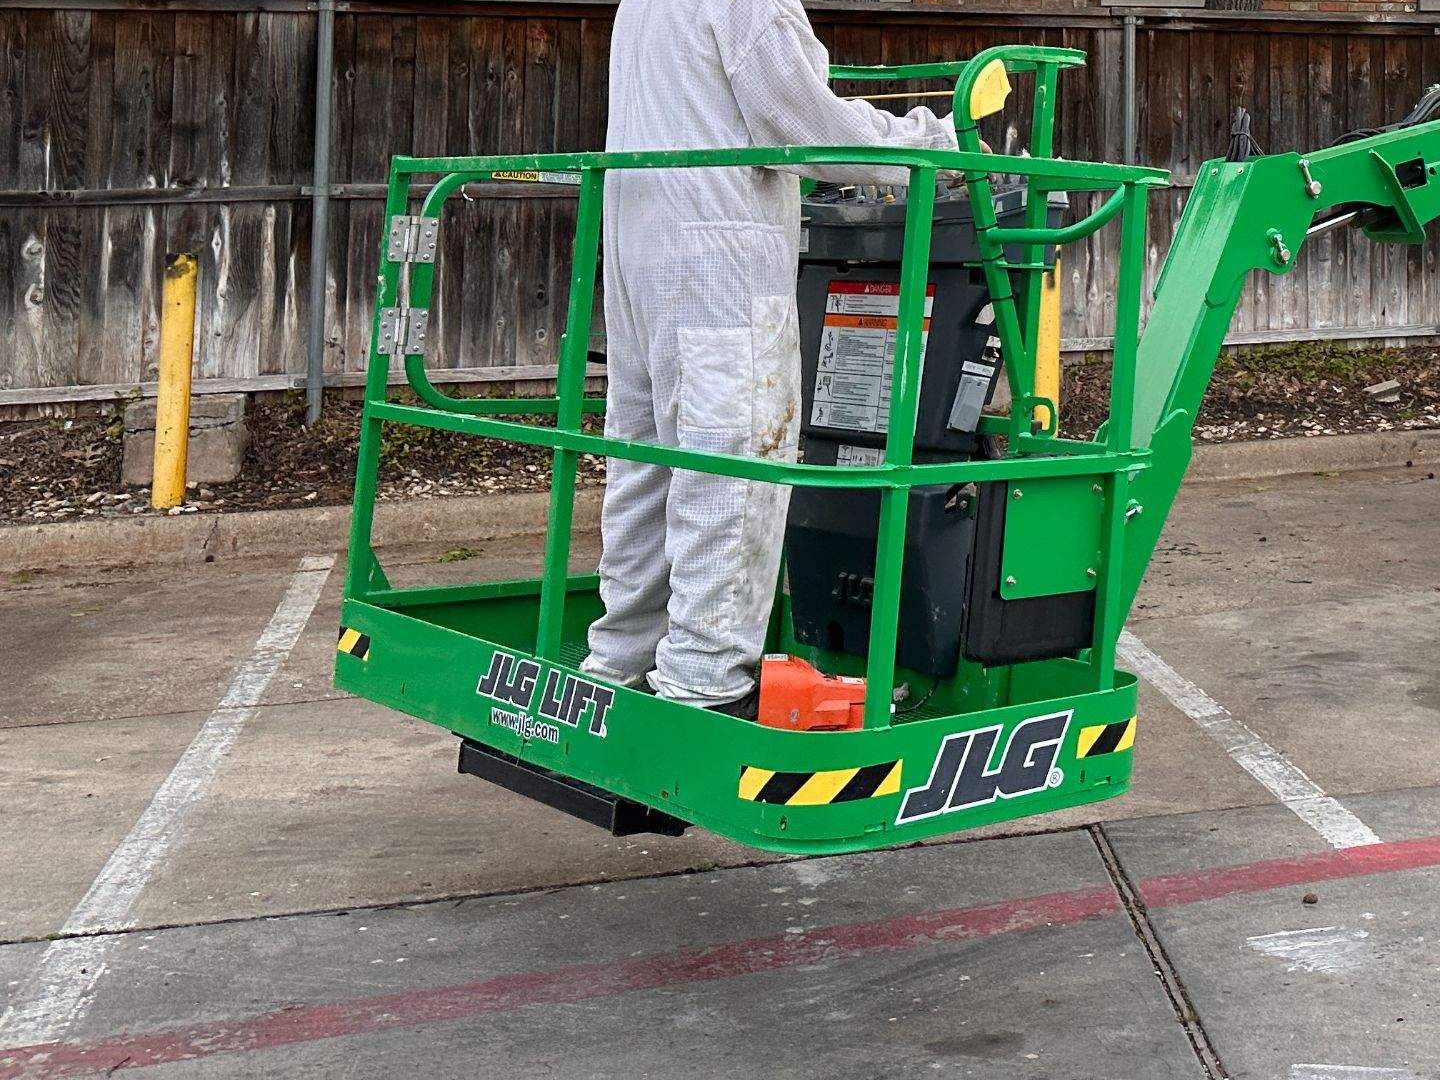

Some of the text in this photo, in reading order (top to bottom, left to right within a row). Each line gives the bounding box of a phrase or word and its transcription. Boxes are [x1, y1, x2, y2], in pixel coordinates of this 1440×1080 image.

[501, 171, 537, 180] CAUTION
[870, 284, 893, 293] DANGER
[476, 651, 615, 735] JLG LIFT
[491, 707, 559, 743] www.jlg.com
[895, 710, 1074, 825] JLG
